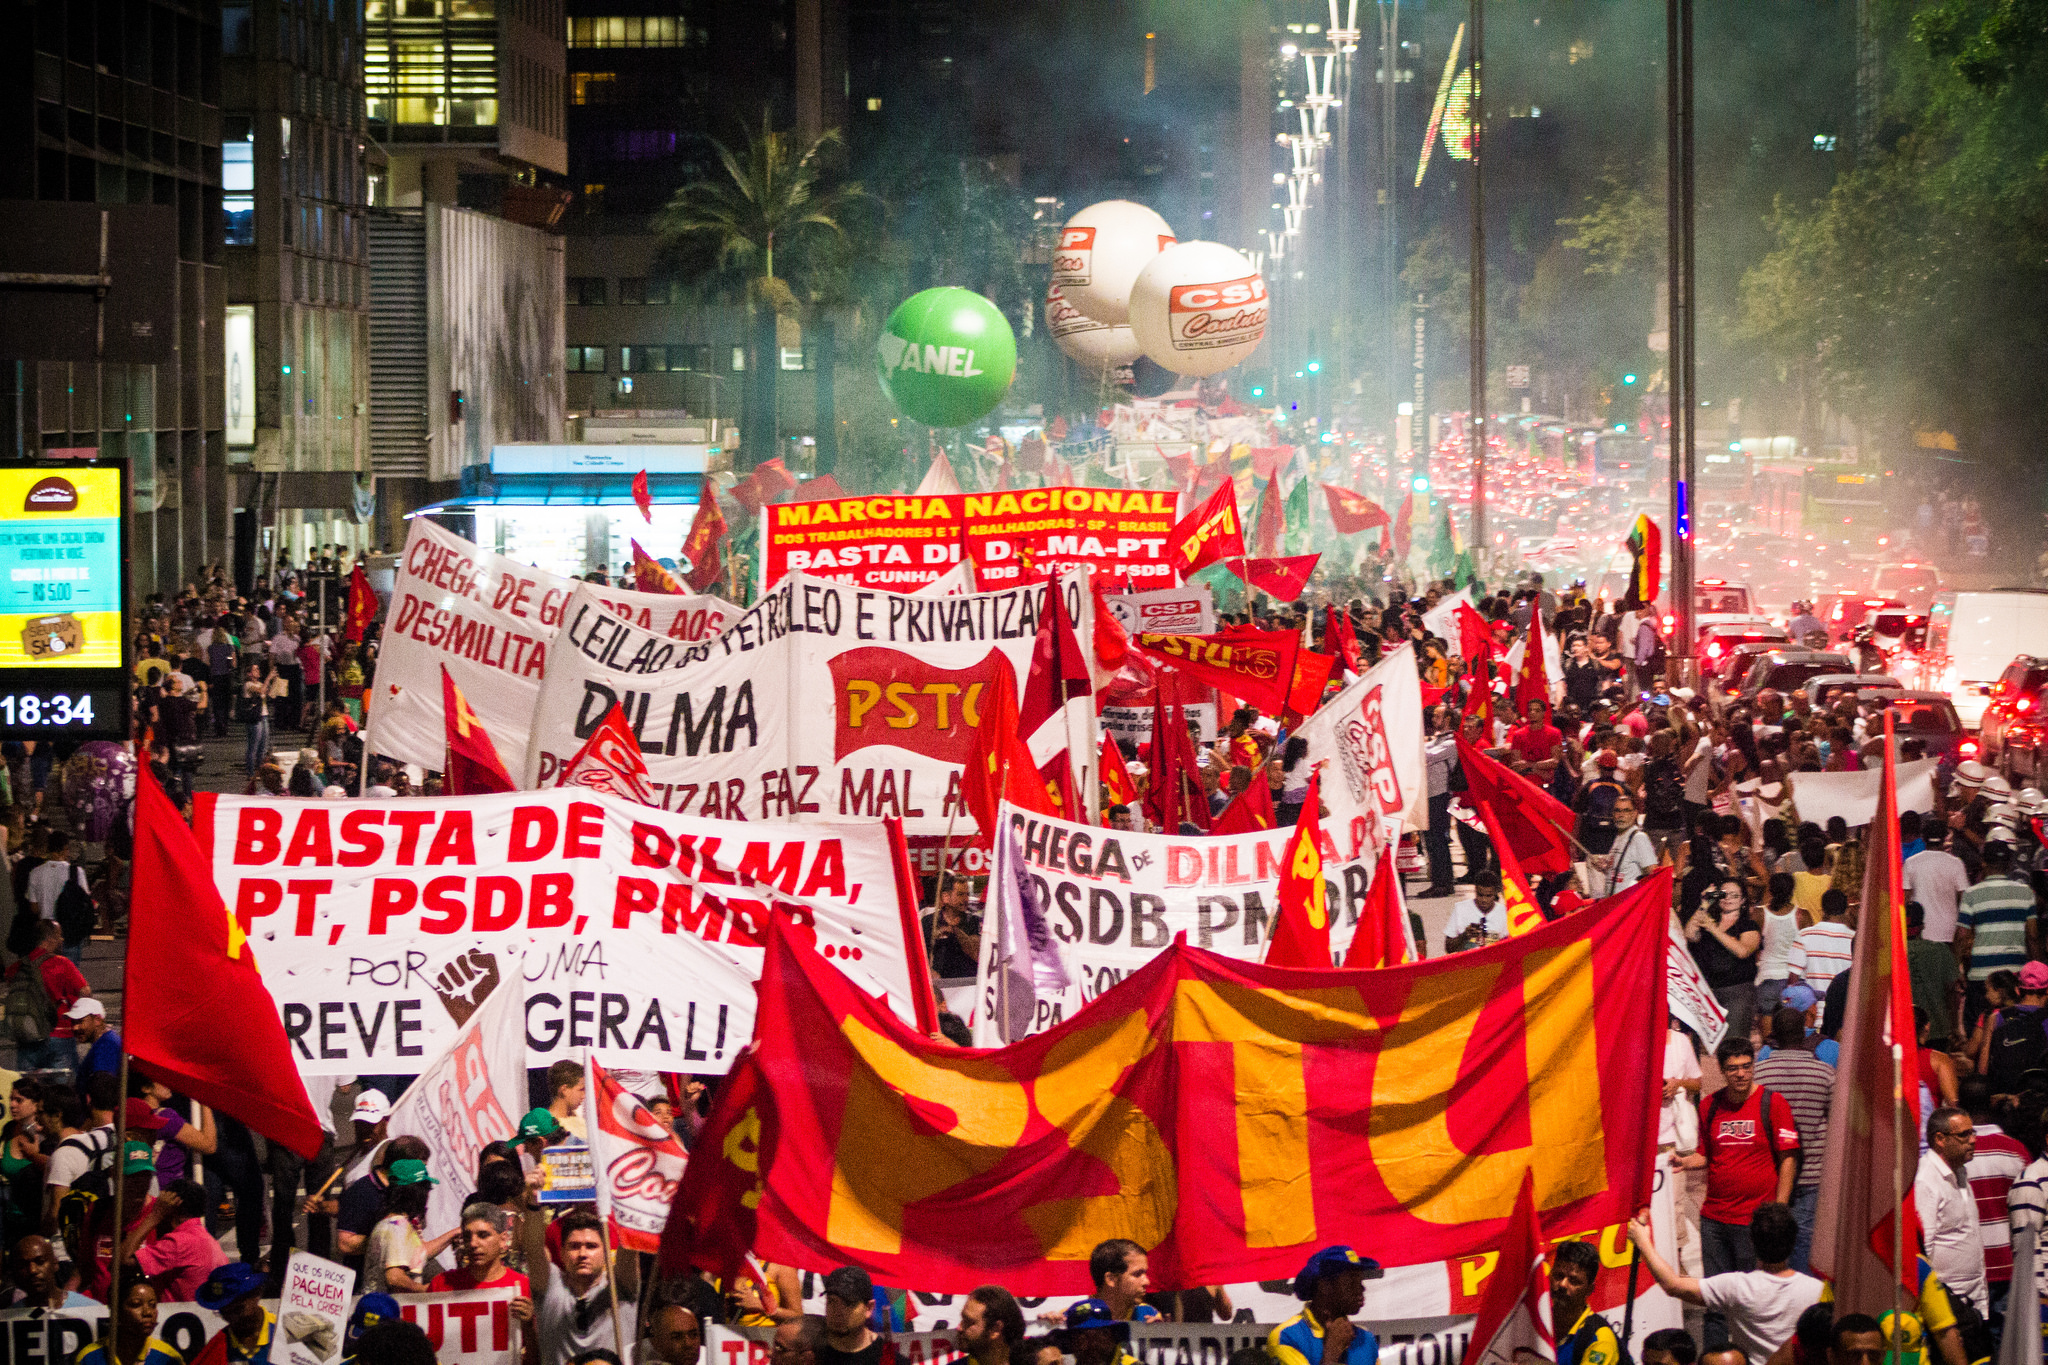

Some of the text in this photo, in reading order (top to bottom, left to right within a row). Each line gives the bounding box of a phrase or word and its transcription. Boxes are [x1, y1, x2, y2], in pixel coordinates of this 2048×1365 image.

[1180, 279, 1265, 309] CSP
[900, 344, 983, 379] ANEL
[777, 490, 1174, 526] MARCHA NACIONAL
[774, 533, 804, 545] DOS
[809, 526, 933, 543] TRABALHADORES
[936, 527, 946, 538] E
[1087, 519, 1107, 531] SP
[1117, 521, 1171, 532] BRASIL
[786, 543, 912, 570] BASTA
[1115, 564, 1171, 577] PSDB
[408, 537, 482, 603] CHEGA
[492, 572, 535, 618] DE
[668, 609, 725, 642] AOS
[856, 592, 875, 640] E
[1145, 602, 1197, 616] CSP
[393, 593, 546, 680] DESMILITA
[1141, 633, 1233, 669] PSTU
[0, 694, 94, 725] 18:34
[574, 679, 758, 757] DILMA
[761, 765, 820, 819] FAZ
[839, 768, 924, 818] MAL
[233, 801, 863, 906] BASTA DE DILMA,
[1011, 812, 1132, 883] CHEGA
[1132, 848, 1155, 871] DE
[236, 877, 345, 946] PT,
[367, 872, 590, 936] PSDB,
[347, 940, 609, 990] POR UMA
[282, 991, 729, 1062] REVE GERAL!
[826, 938, 1610, 1261] PSTU
[293, 1262, 309, 1275] QUE
[312, 1267, 323, 1278] OS
[290, 1293, 314, 1309] PELA
[292, 1275, 344, 1303] PAGUEM
